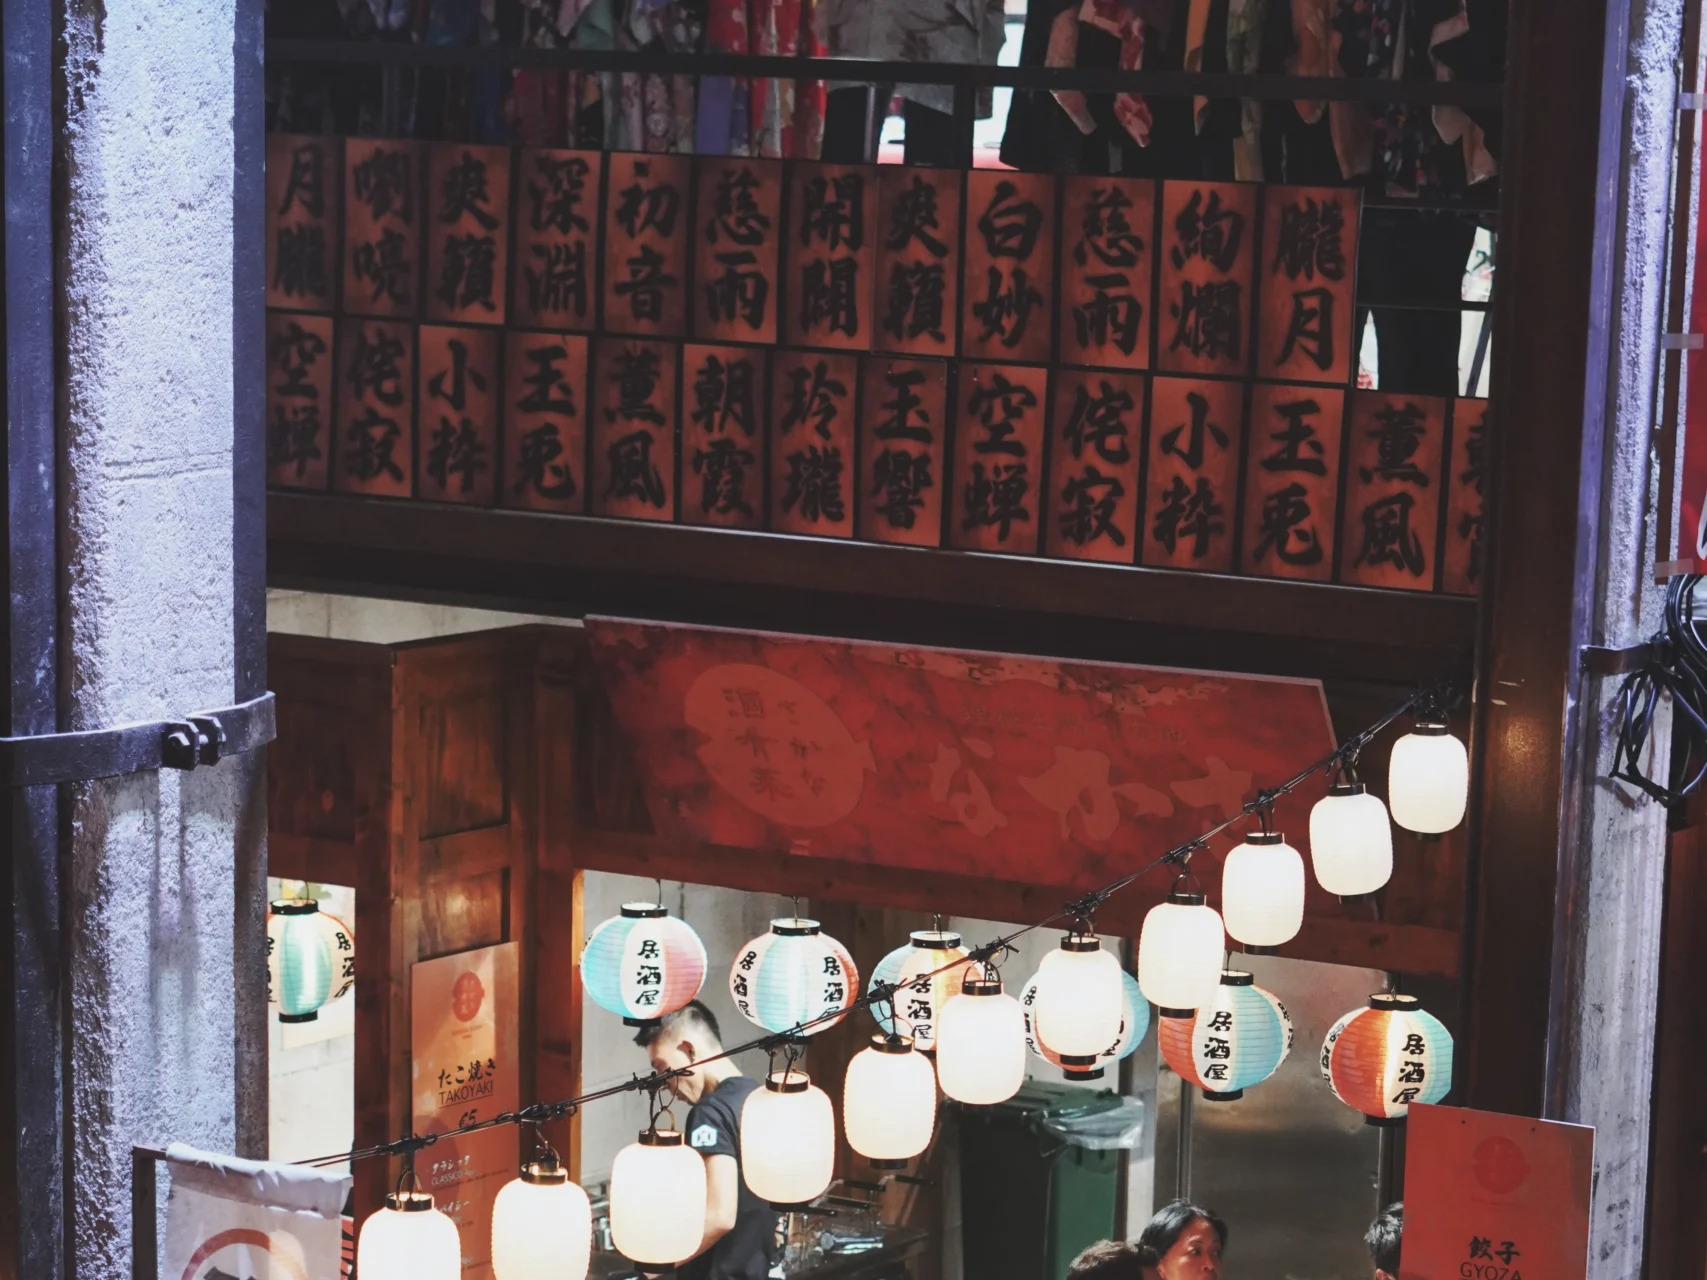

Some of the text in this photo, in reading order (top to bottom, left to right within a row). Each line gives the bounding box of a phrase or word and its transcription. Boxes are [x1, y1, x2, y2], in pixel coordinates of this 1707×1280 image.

[615, 160, 678, 321] 初音
[704, 168, 771, 332] 慈雨
[973, 181, 1044, 348] 白妙
[1071, 186, 1144, 357] 慈雨
[636, 939, 662, 1006] 居酒屋
[905, 974, 935, 1040] 居酒屋
[438, 1057, 497, 1088] たこ焼き
[1203, 1011, 1233, 1082] 居酒屋
[1392, 1034, 1426, 1105] 居酒屋
[438, 1079, 494, 1106] TAKOYAKI
[1468, 1235, 1521, 1266] 餃子
